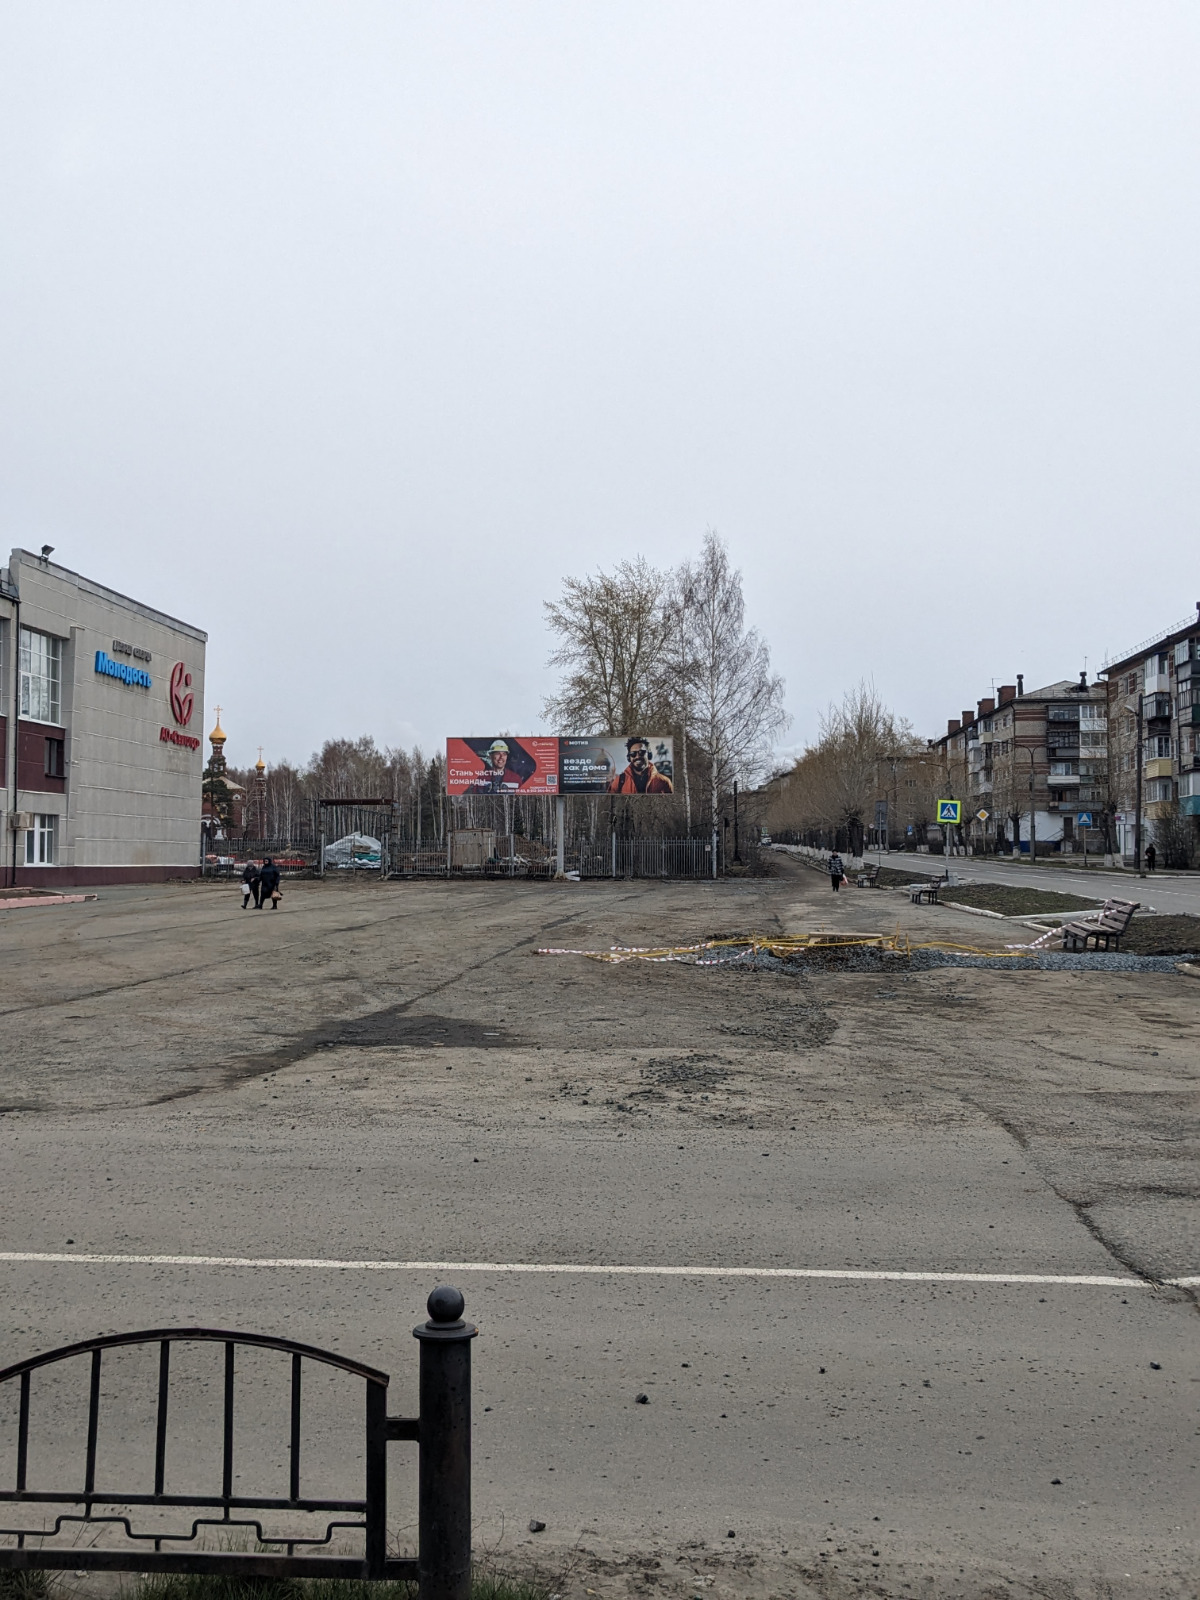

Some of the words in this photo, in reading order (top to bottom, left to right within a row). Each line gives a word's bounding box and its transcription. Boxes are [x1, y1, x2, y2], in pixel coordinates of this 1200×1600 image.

[95, 650, 152, 688] Молодость
[449, 768, 473, 776] Стань
[449, 778, 486, 786] команды
